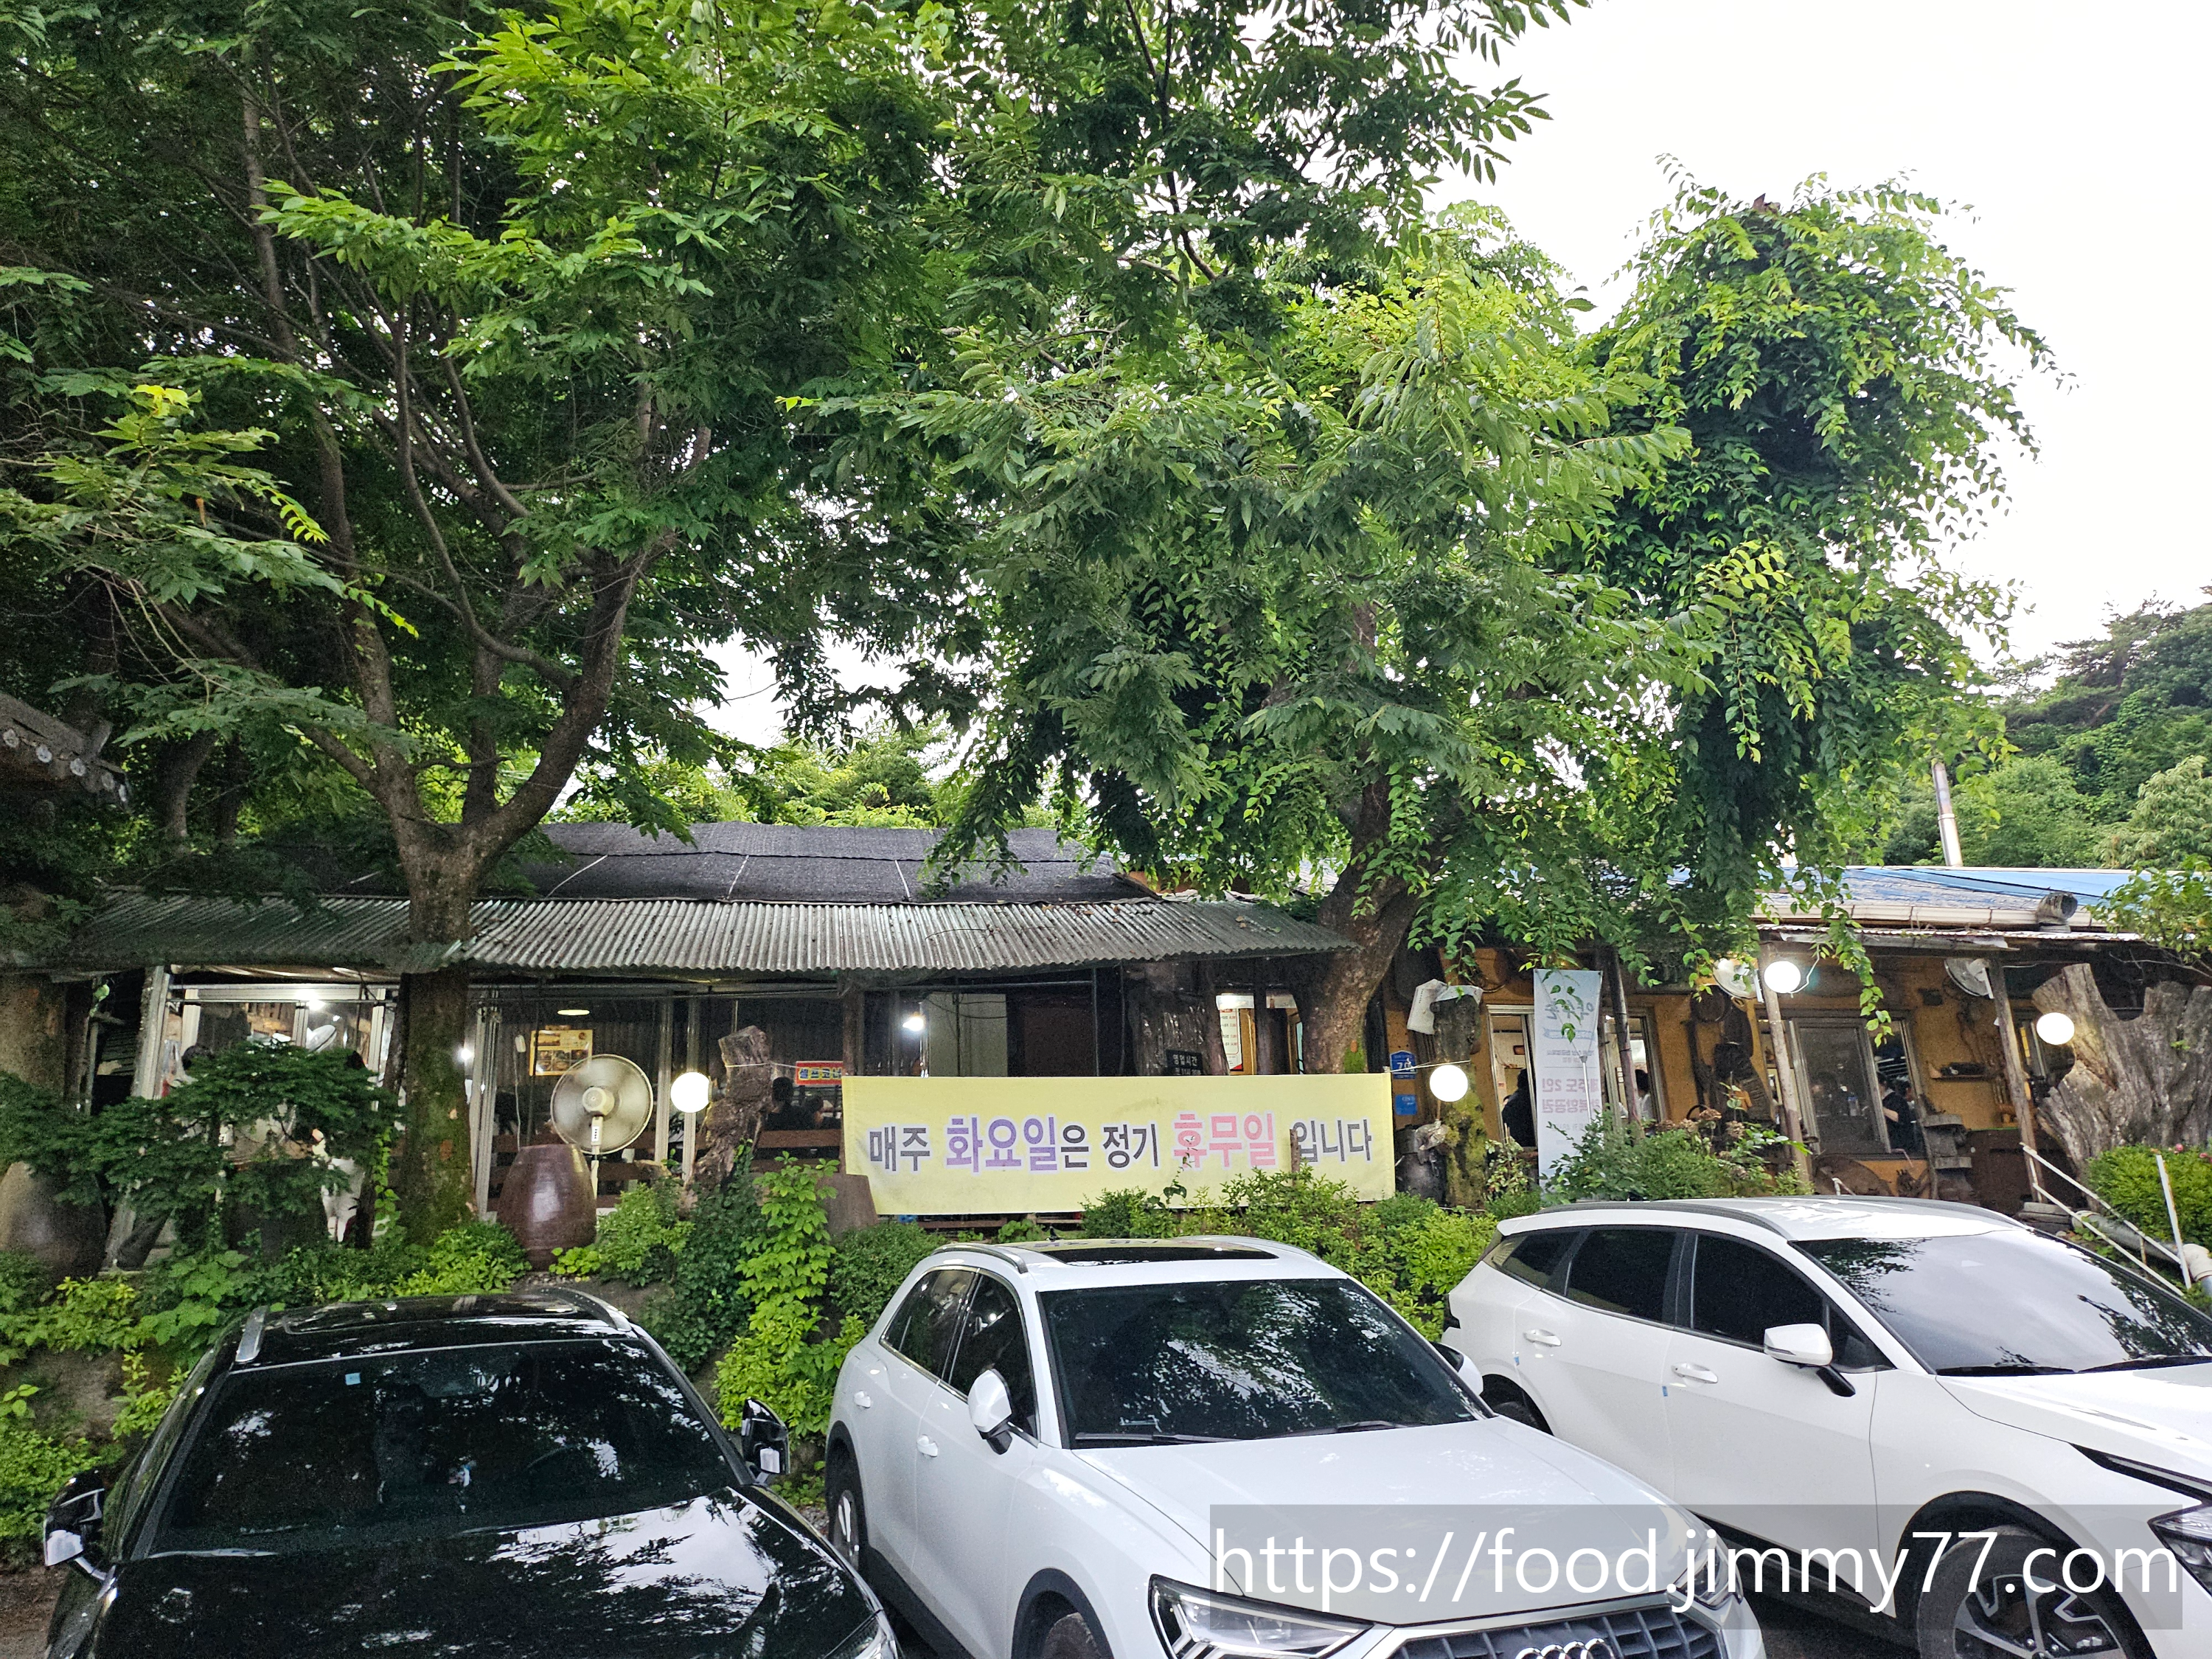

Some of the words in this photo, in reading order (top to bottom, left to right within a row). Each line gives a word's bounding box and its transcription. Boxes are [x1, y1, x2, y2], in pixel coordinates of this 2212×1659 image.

[869, 1126, 931, 1172] 매주
[946, 1116, 1089, 1173] 화요일은
[1102, 1124, 1158, 1168] 정기
[1174, 1113, 1277, 1168] 휴무일
[1293, 1119, 1372, 1163] 입니다
